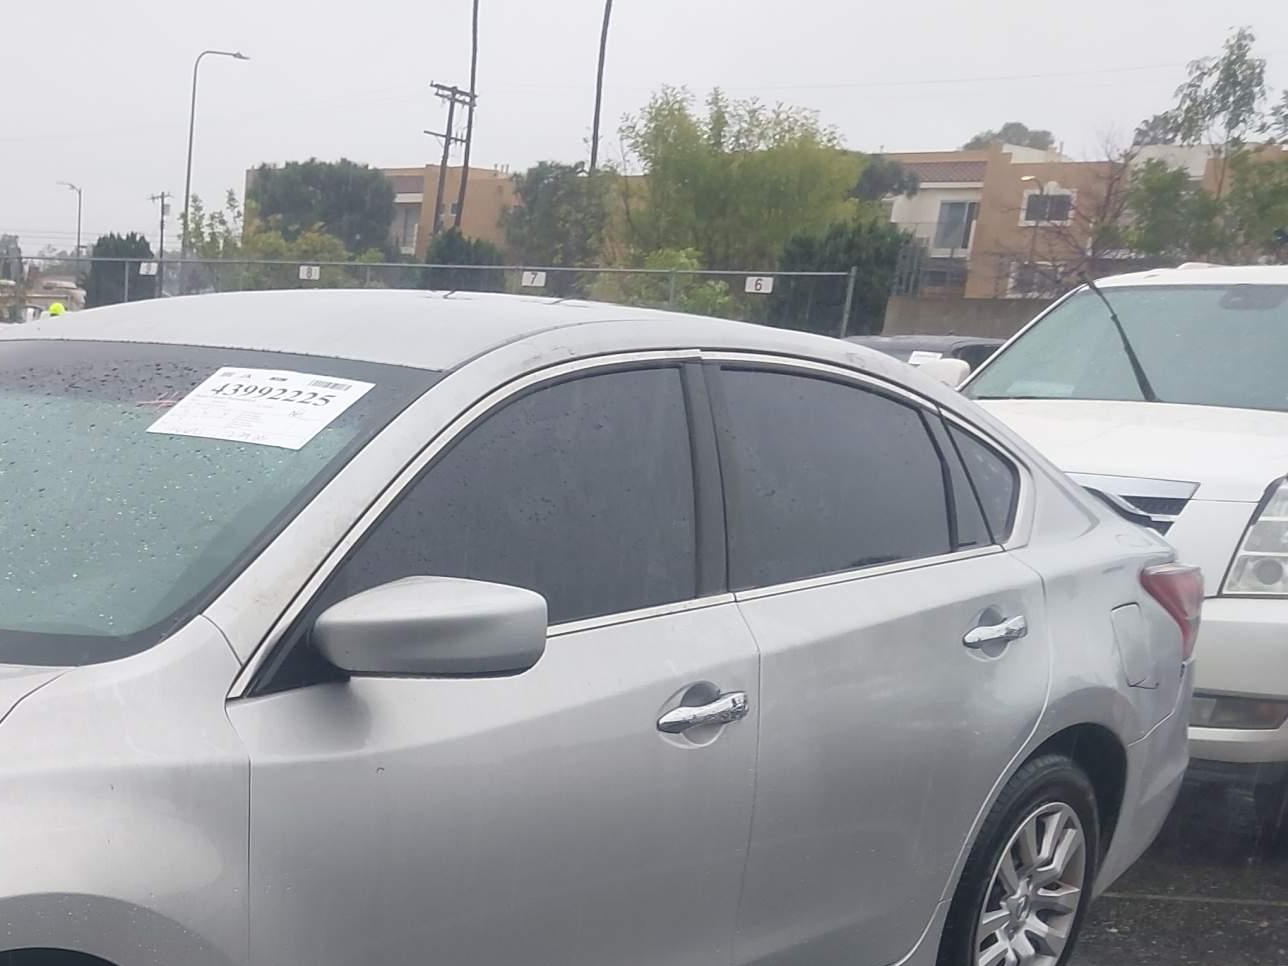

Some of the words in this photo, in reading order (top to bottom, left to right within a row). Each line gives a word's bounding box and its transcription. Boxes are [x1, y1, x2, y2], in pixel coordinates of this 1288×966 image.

[530, 272, 538, 285] 7
[754, 278, 763, 291] 6
[211, 382, 336, 407] 43992225
